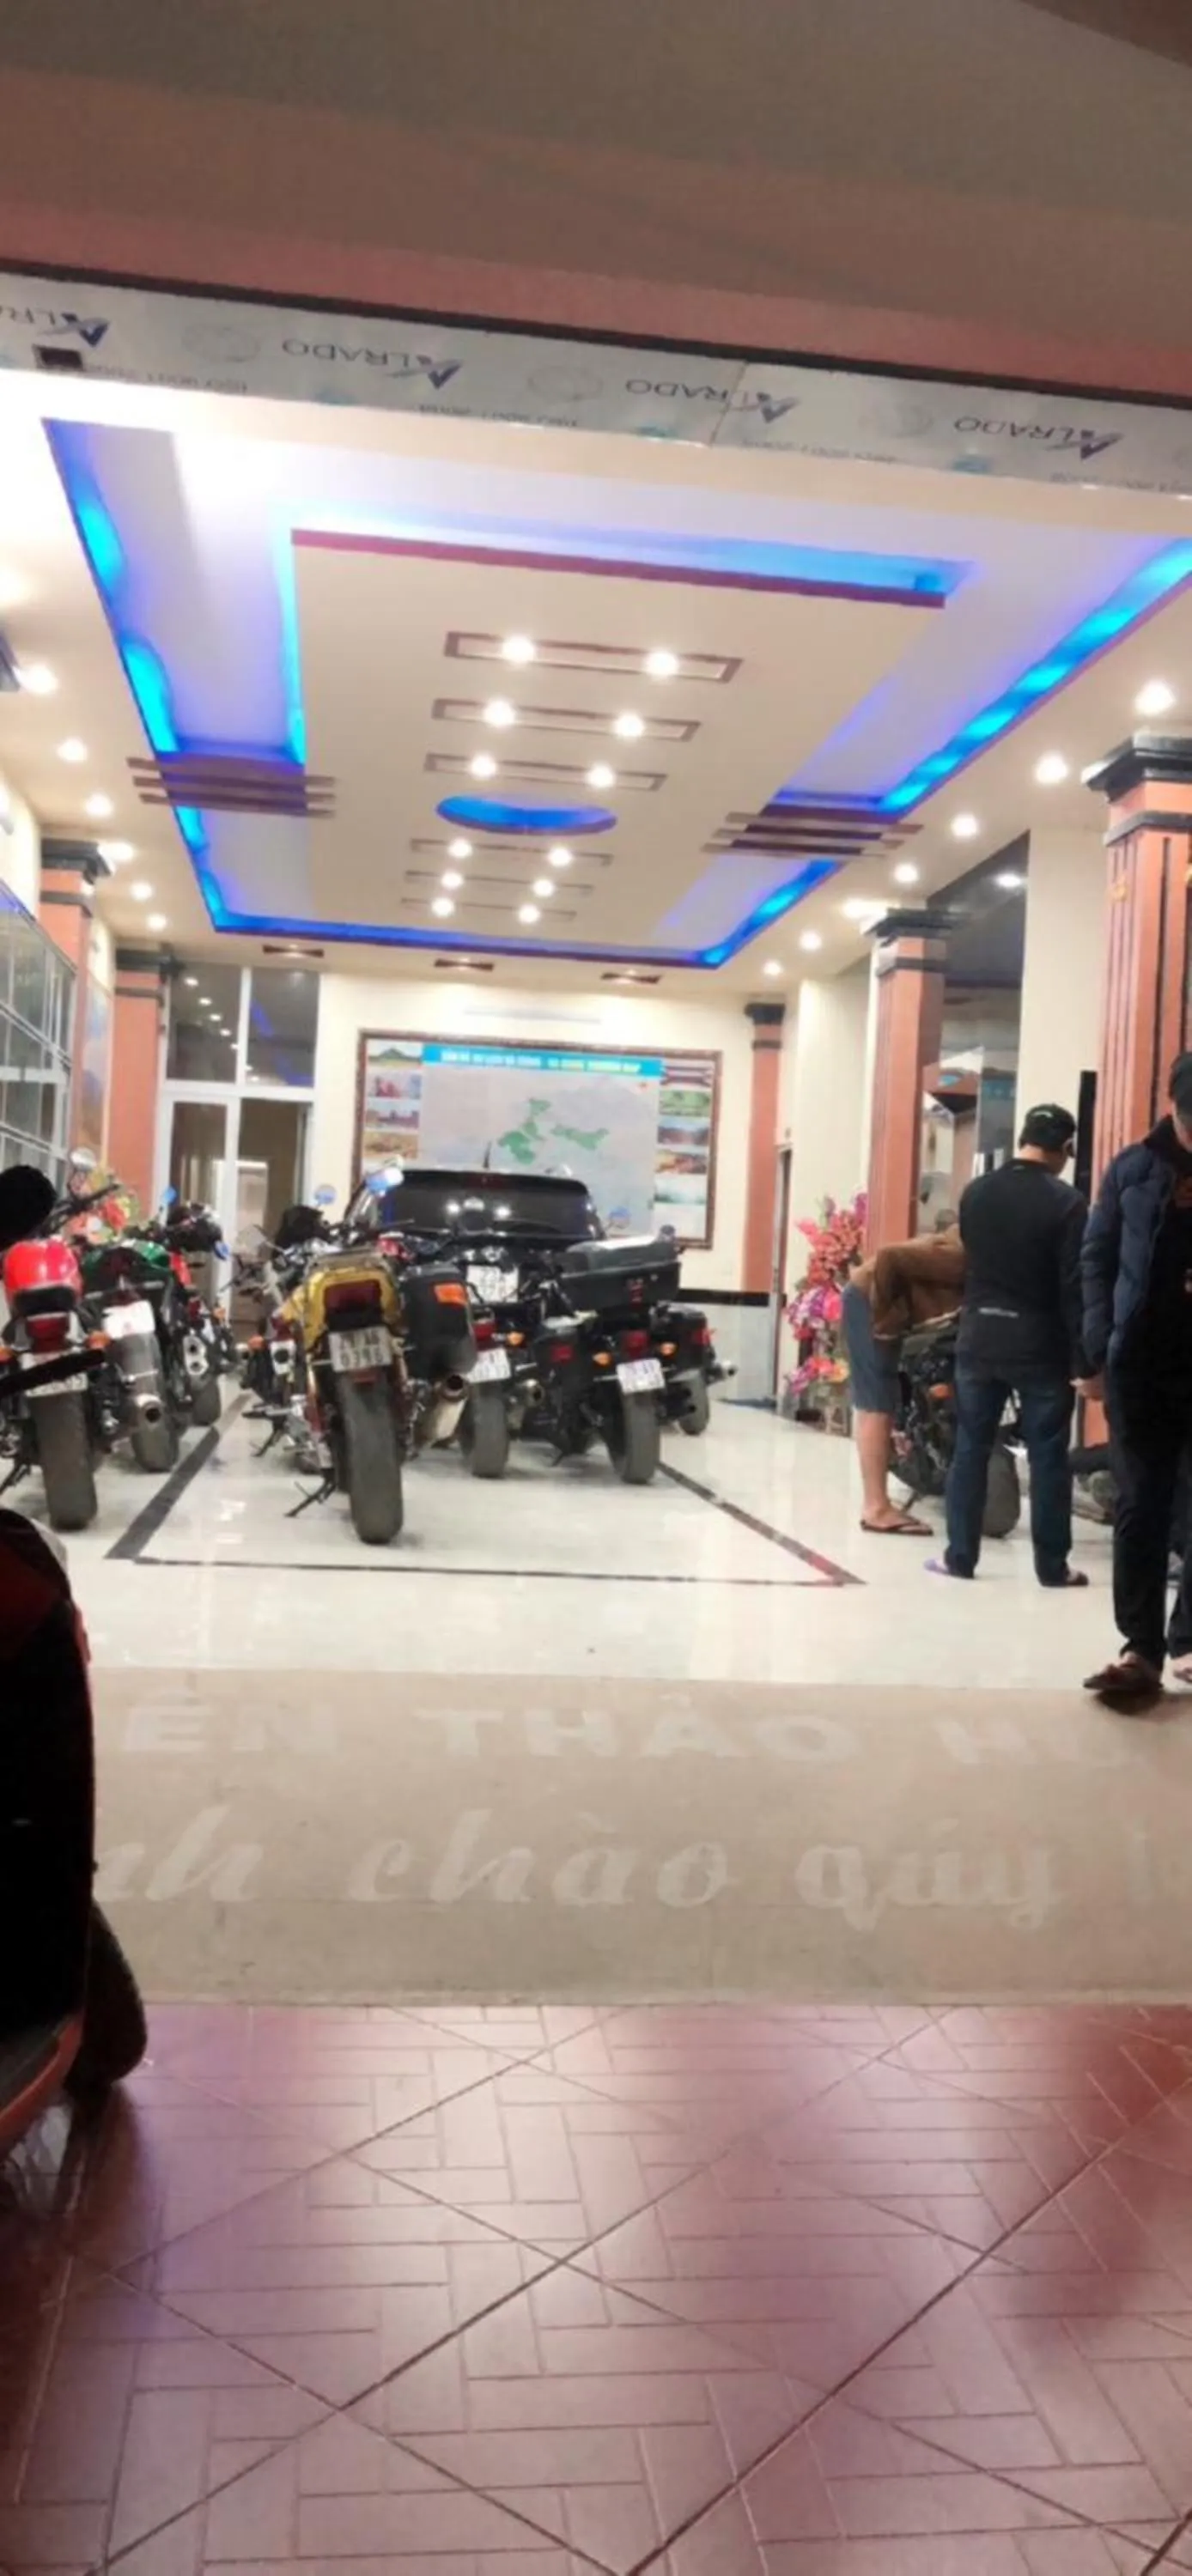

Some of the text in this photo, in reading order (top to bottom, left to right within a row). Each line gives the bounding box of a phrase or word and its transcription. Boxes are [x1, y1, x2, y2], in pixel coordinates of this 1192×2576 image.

[282, 338, 464, 390] ALRADO
[953, 416, 1125, 461] ALRADO
[348, 1807, 737, 1908] chào
